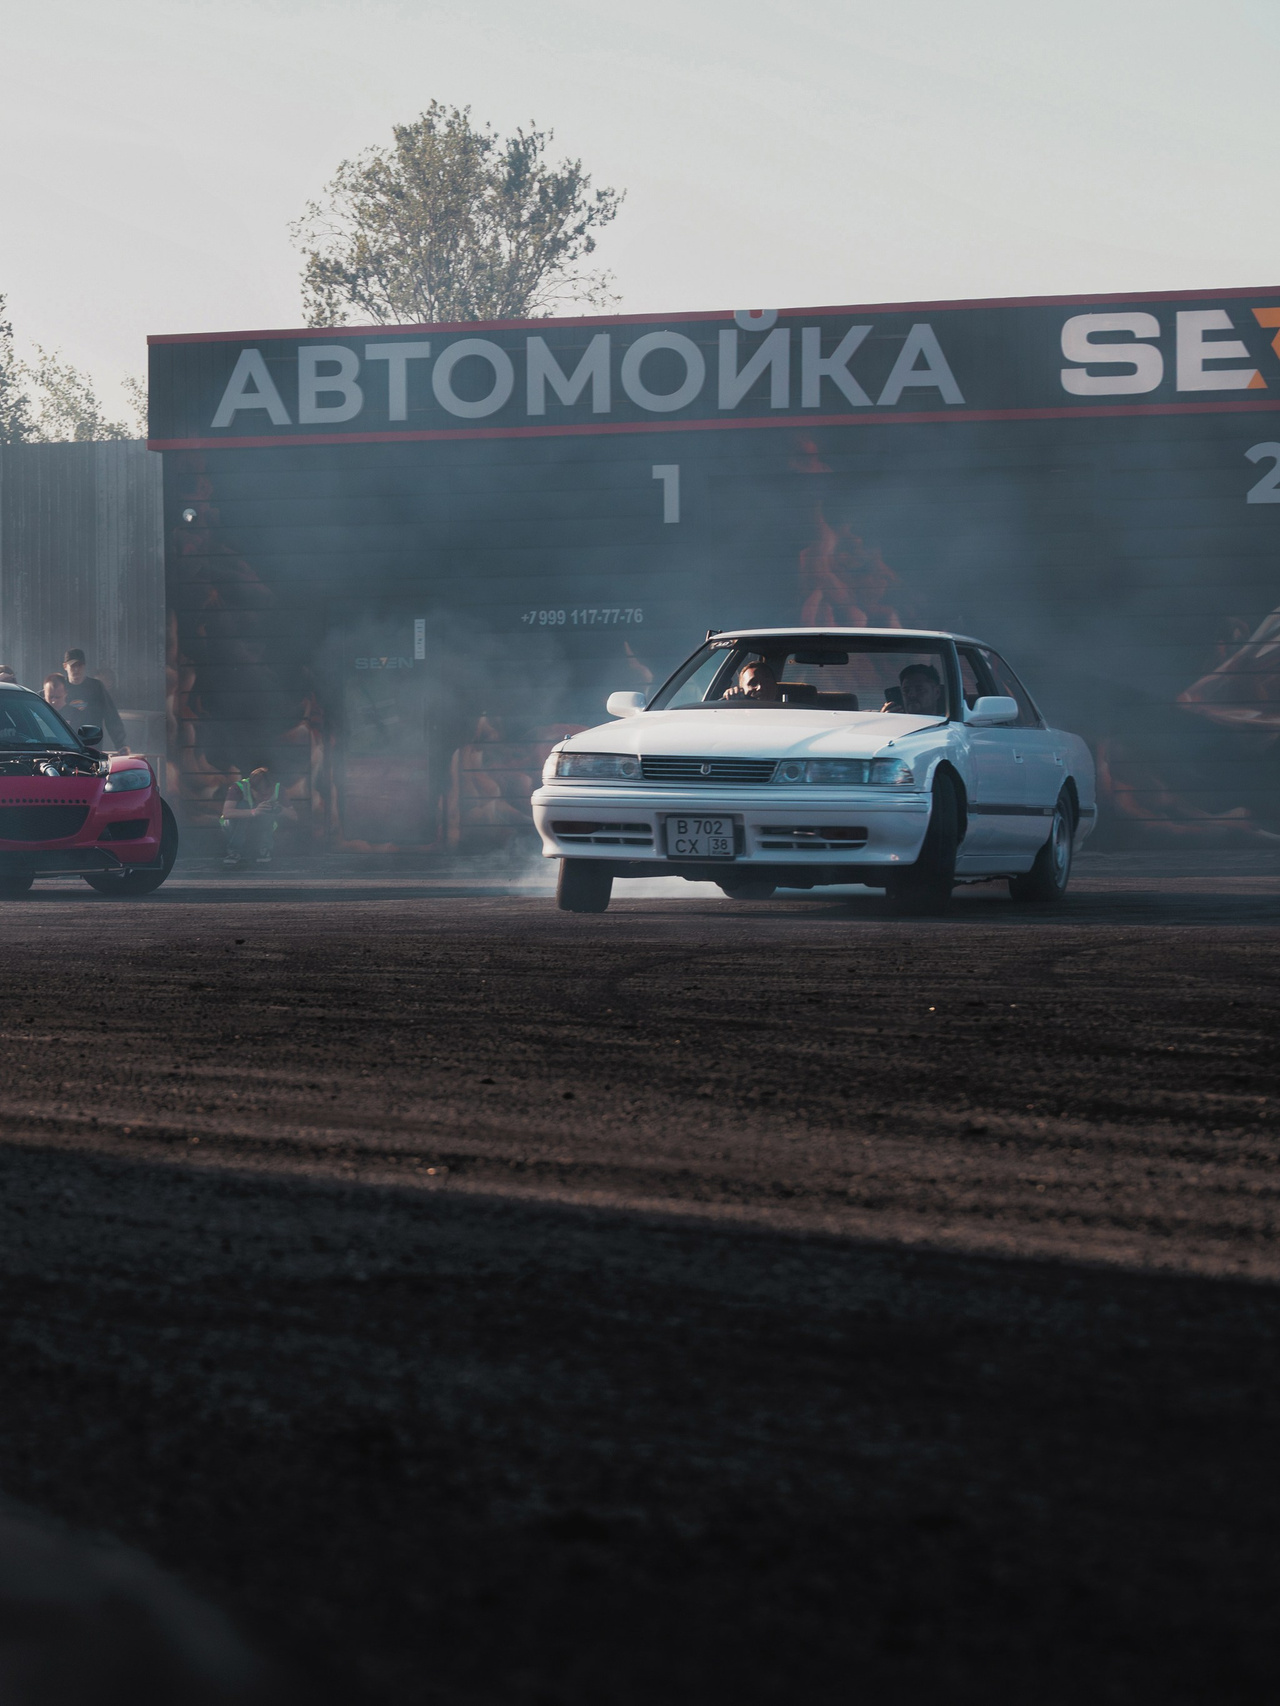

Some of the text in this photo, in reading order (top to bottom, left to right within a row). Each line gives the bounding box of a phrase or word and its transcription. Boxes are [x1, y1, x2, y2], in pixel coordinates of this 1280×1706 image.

[210, 309, 967, 428] АВТОМОЙКА
[1244, 442, 1280, 504] 2
[652, 464, 680, 524] 1
[570, 608, 644, 625] 117-77-76
[693, 820, 723, 835] 702
[712, 838, 728, 850] 38
